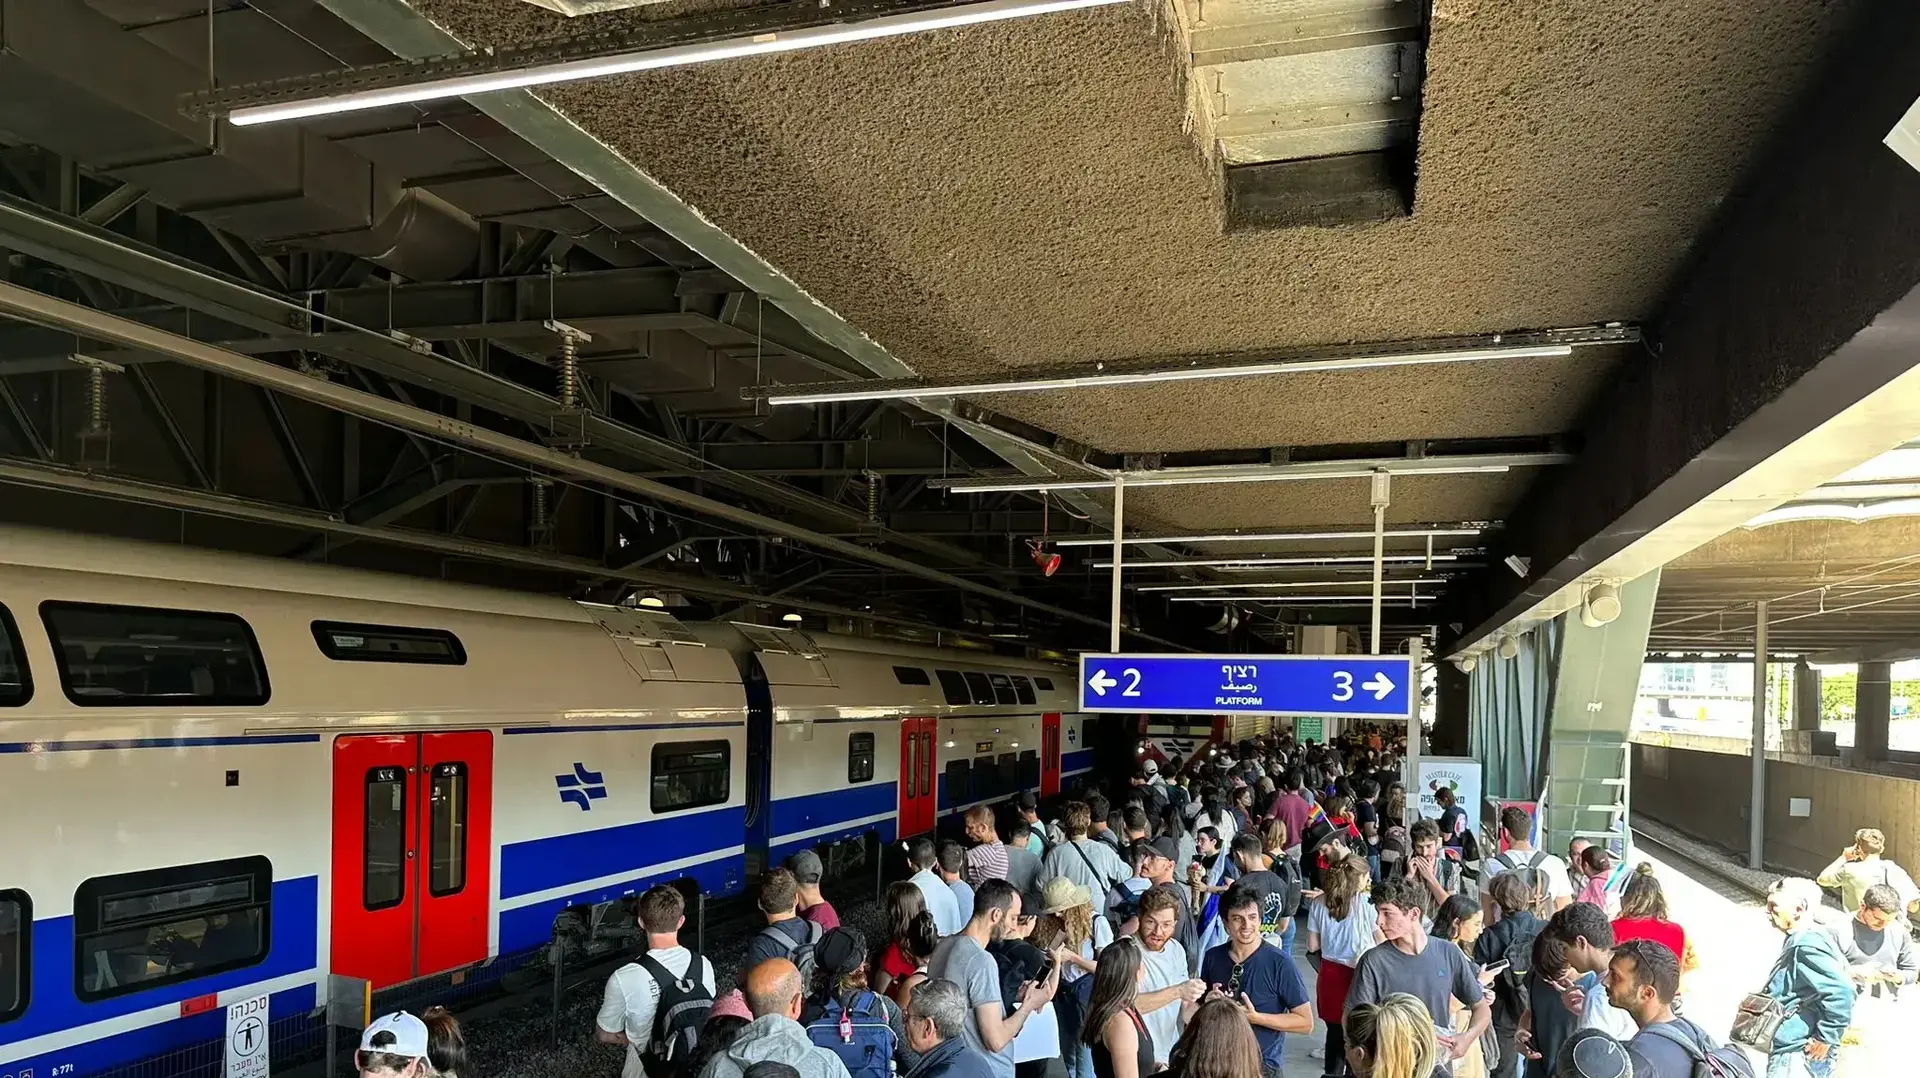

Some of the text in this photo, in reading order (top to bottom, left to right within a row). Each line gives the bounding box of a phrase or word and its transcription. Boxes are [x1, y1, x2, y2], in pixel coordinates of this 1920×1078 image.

[1121, 667, 1142, 697] 2
[1221, 664, 1258, 681] רציף
[1220, 680, 1258, 694] رصيف
[1331, 670, 1354, 702] 3
[1214, 696, 1263, 706] PLATFORM
[230, 996, 267, 1020] סכנה!
[230, 1052, 267, 1072] אין מעבר
